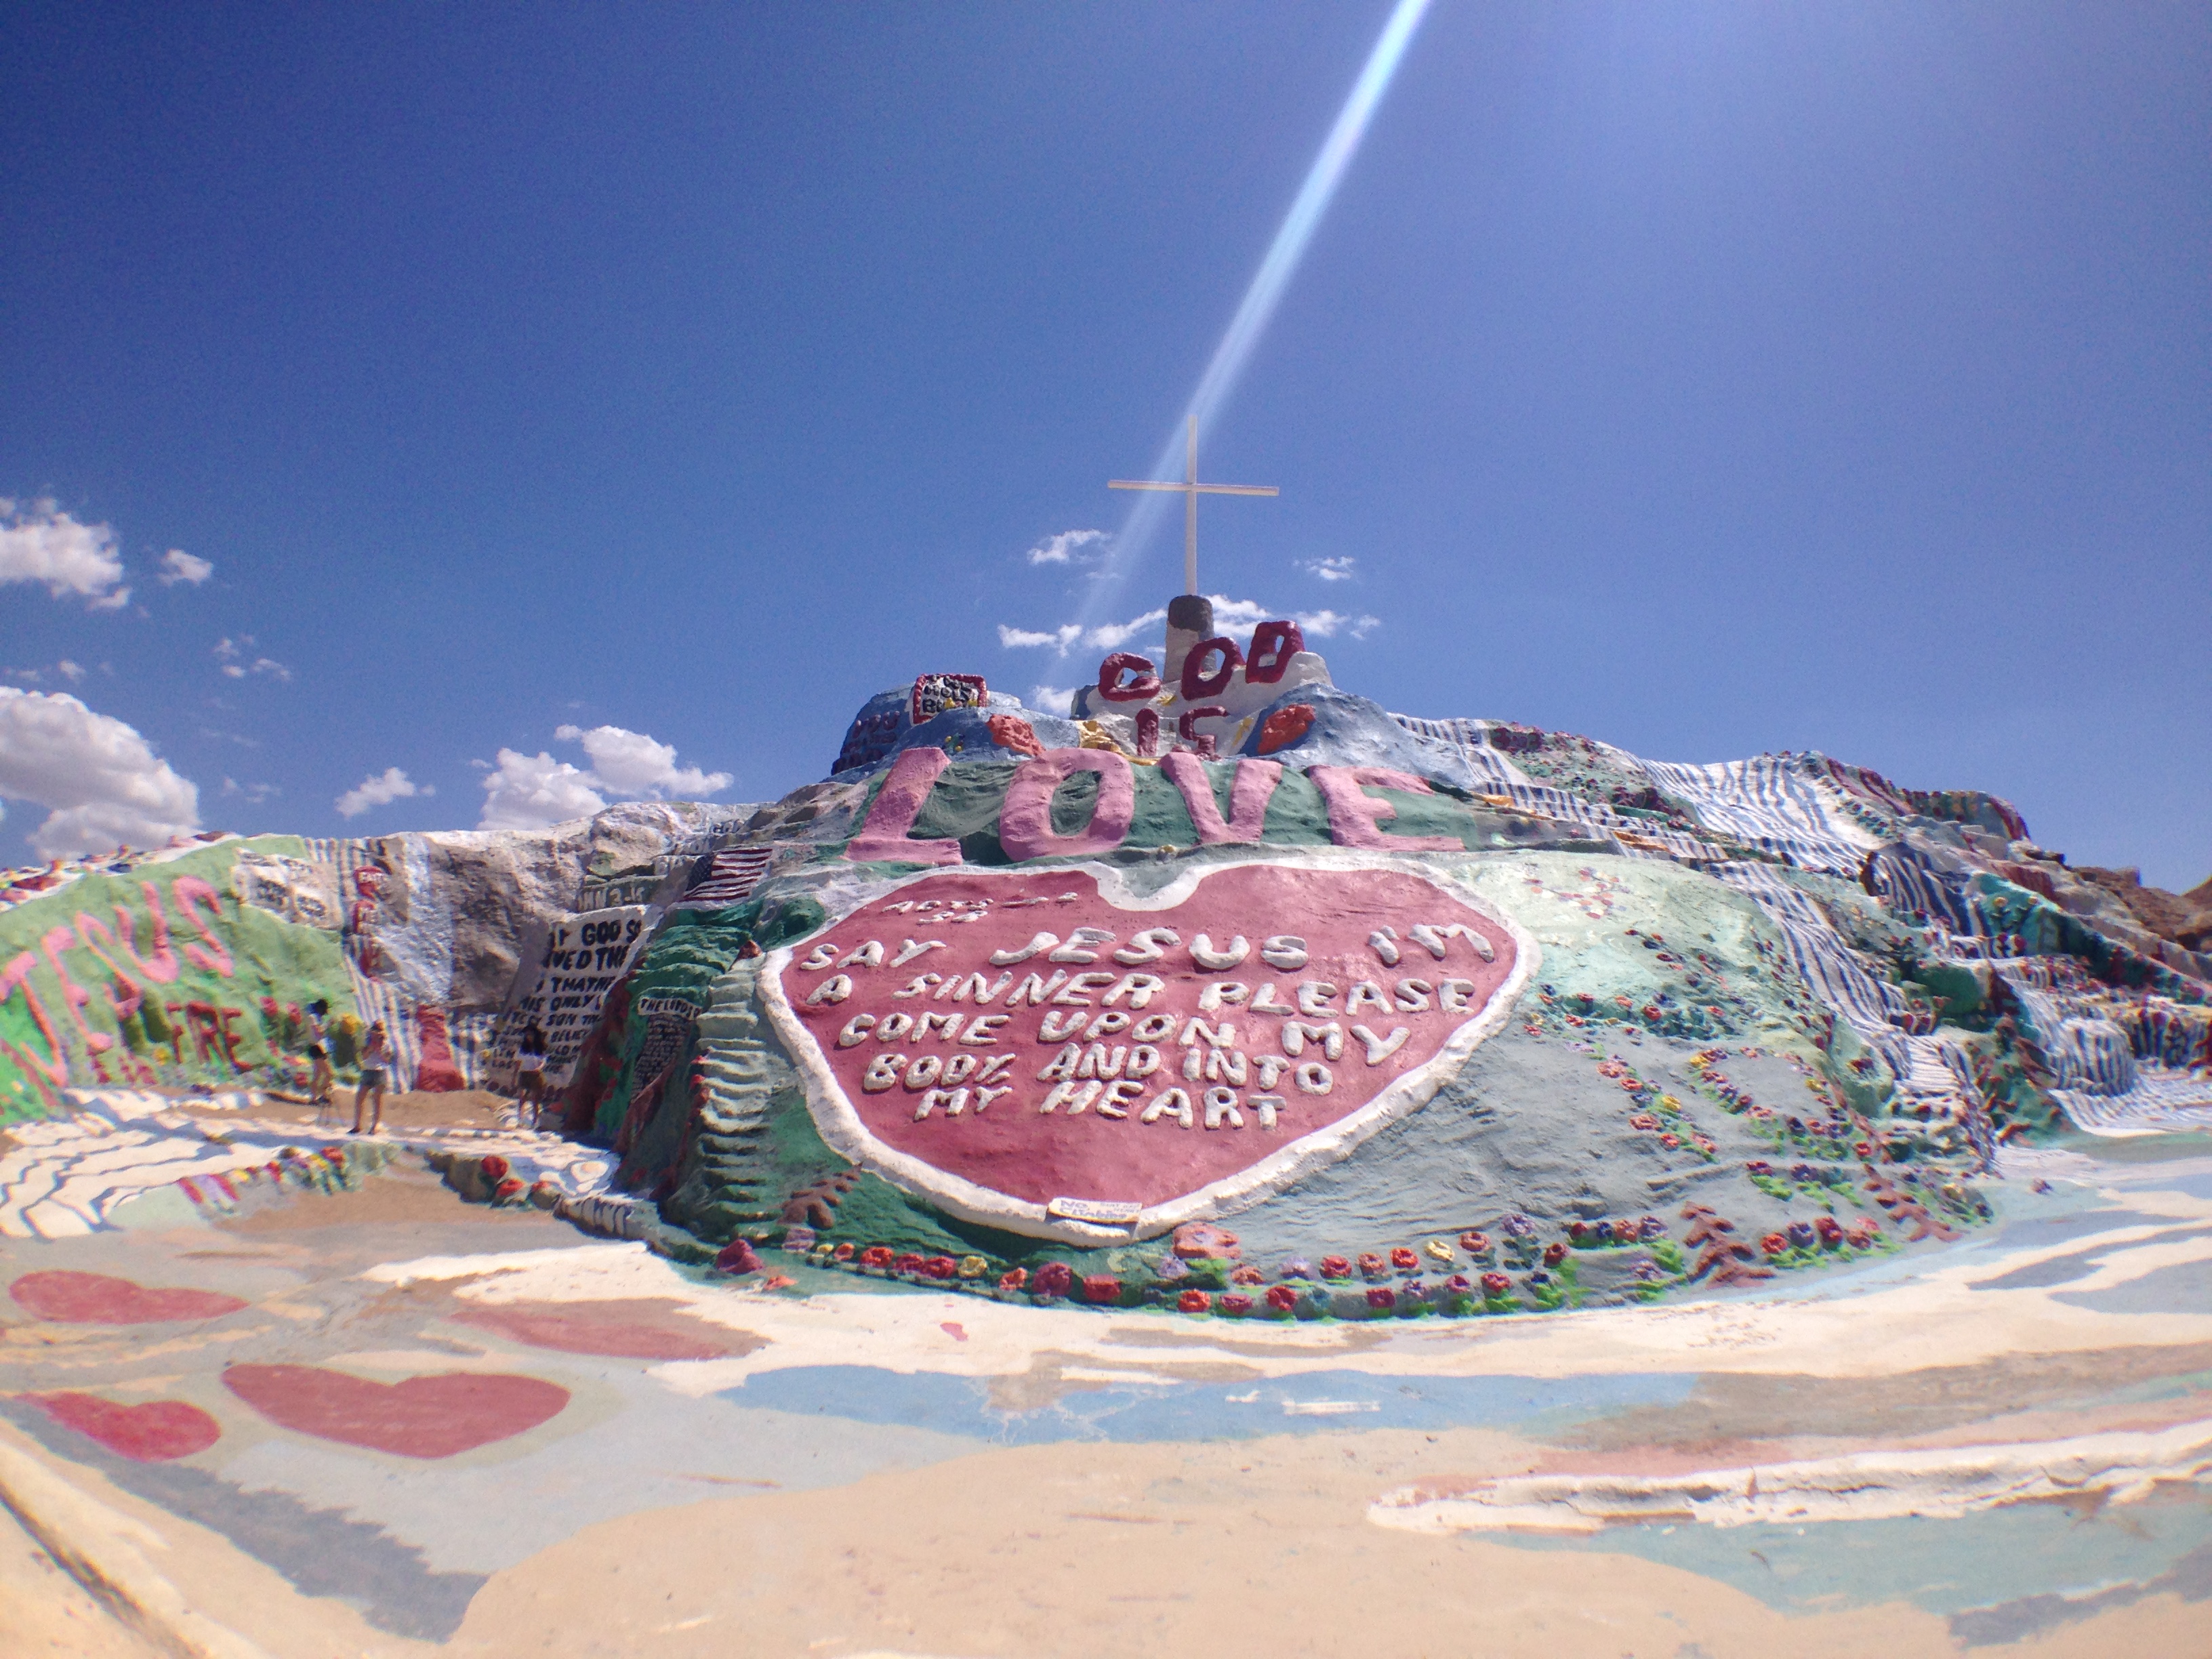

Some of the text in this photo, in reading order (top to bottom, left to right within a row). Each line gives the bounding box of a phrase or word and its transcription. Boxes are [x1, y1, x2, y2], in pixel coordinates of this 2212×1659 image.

[1099, 620, 1305, 701] GOD
[1135, 705, 1228, 761] IS
[839, 746, 1465, 865] LOVE
[581, 919, 621, 946] GOD
[800, 923, 1494, 970] SAY JESUS I'M
[0, 876, 234, 1088] JESUS
[806, 969, 1475, 1017] A SINNER PLEASE
[838, 1010, 1411, 1066] COME UPON MY
[1037, 1042, 1161, 1082] AND
[1183, 1048, 1334, 1096] INTO
[914, 1080, 1288, 1130] MY HEART
